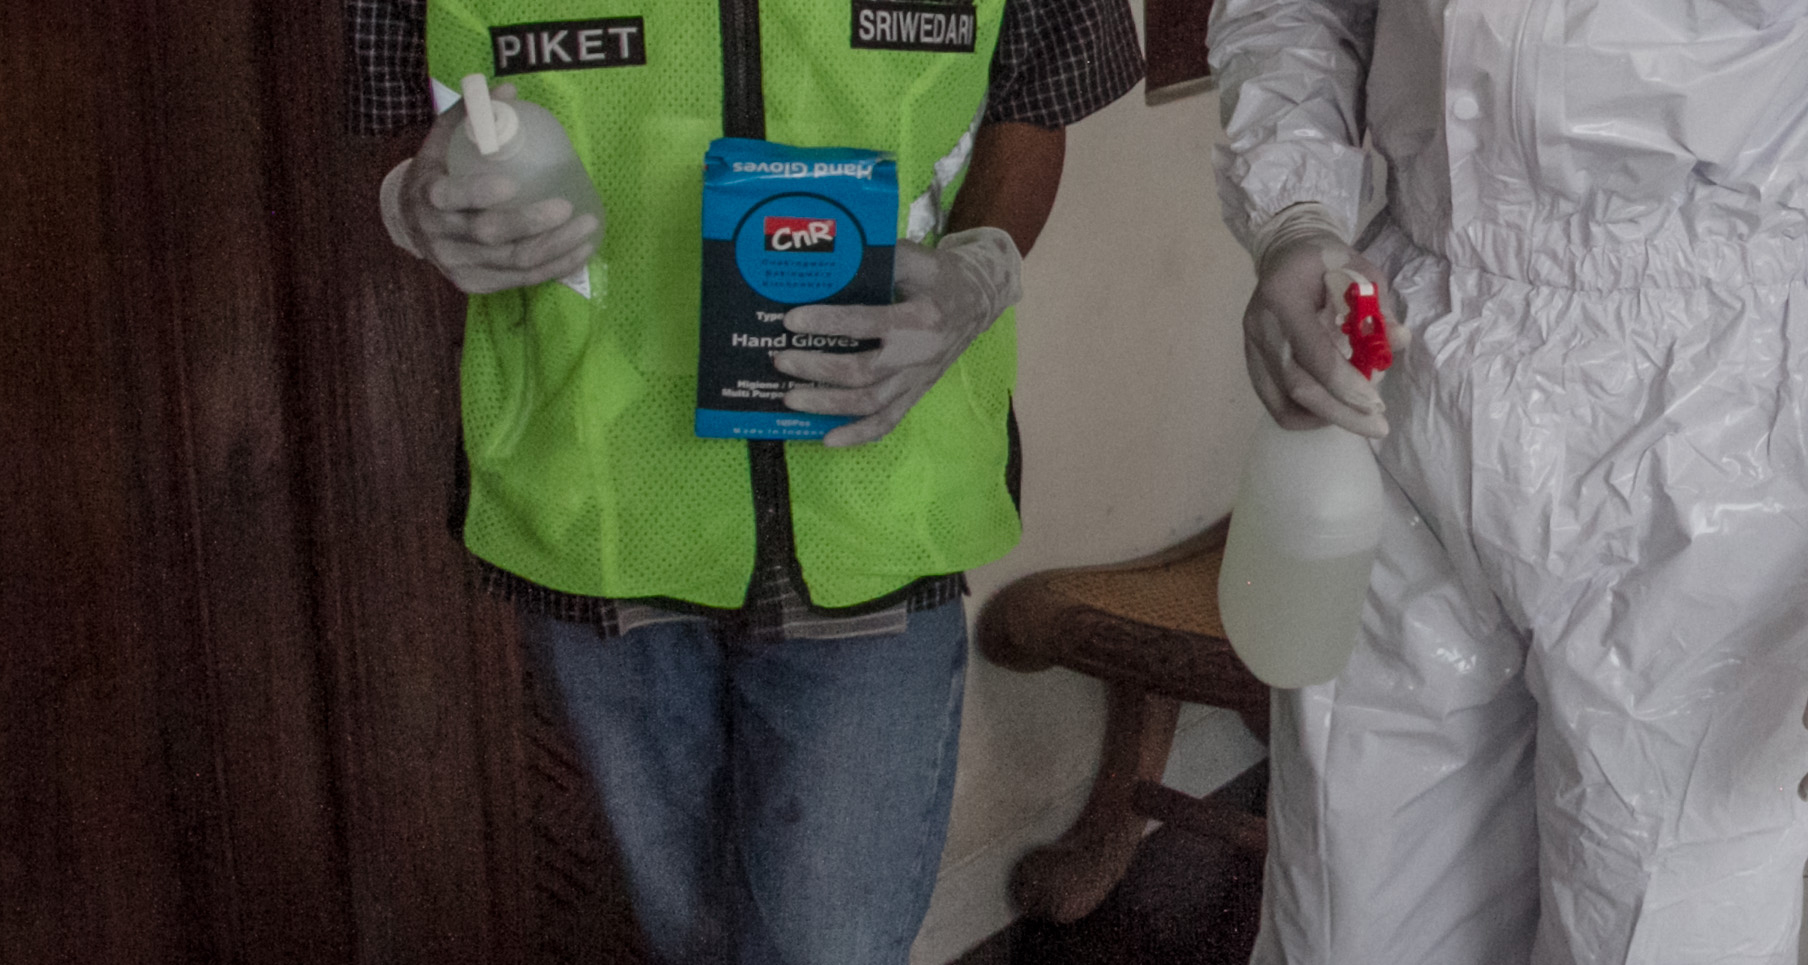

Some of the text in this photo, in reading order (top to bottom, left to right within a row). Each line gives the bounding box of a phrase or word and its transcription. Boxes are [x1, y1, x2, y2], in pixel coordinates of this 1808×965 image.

[858, 10, 973, 47] SRIWEDARI
[499, 26, 639, 69] PIKET
[732, 161, 873, 180] Hand Gloves
[771, 221, 834, 251] CnR
[731, 333, 859, 348] Hand Gloves
[751, 390, 785, 400] Purpo
